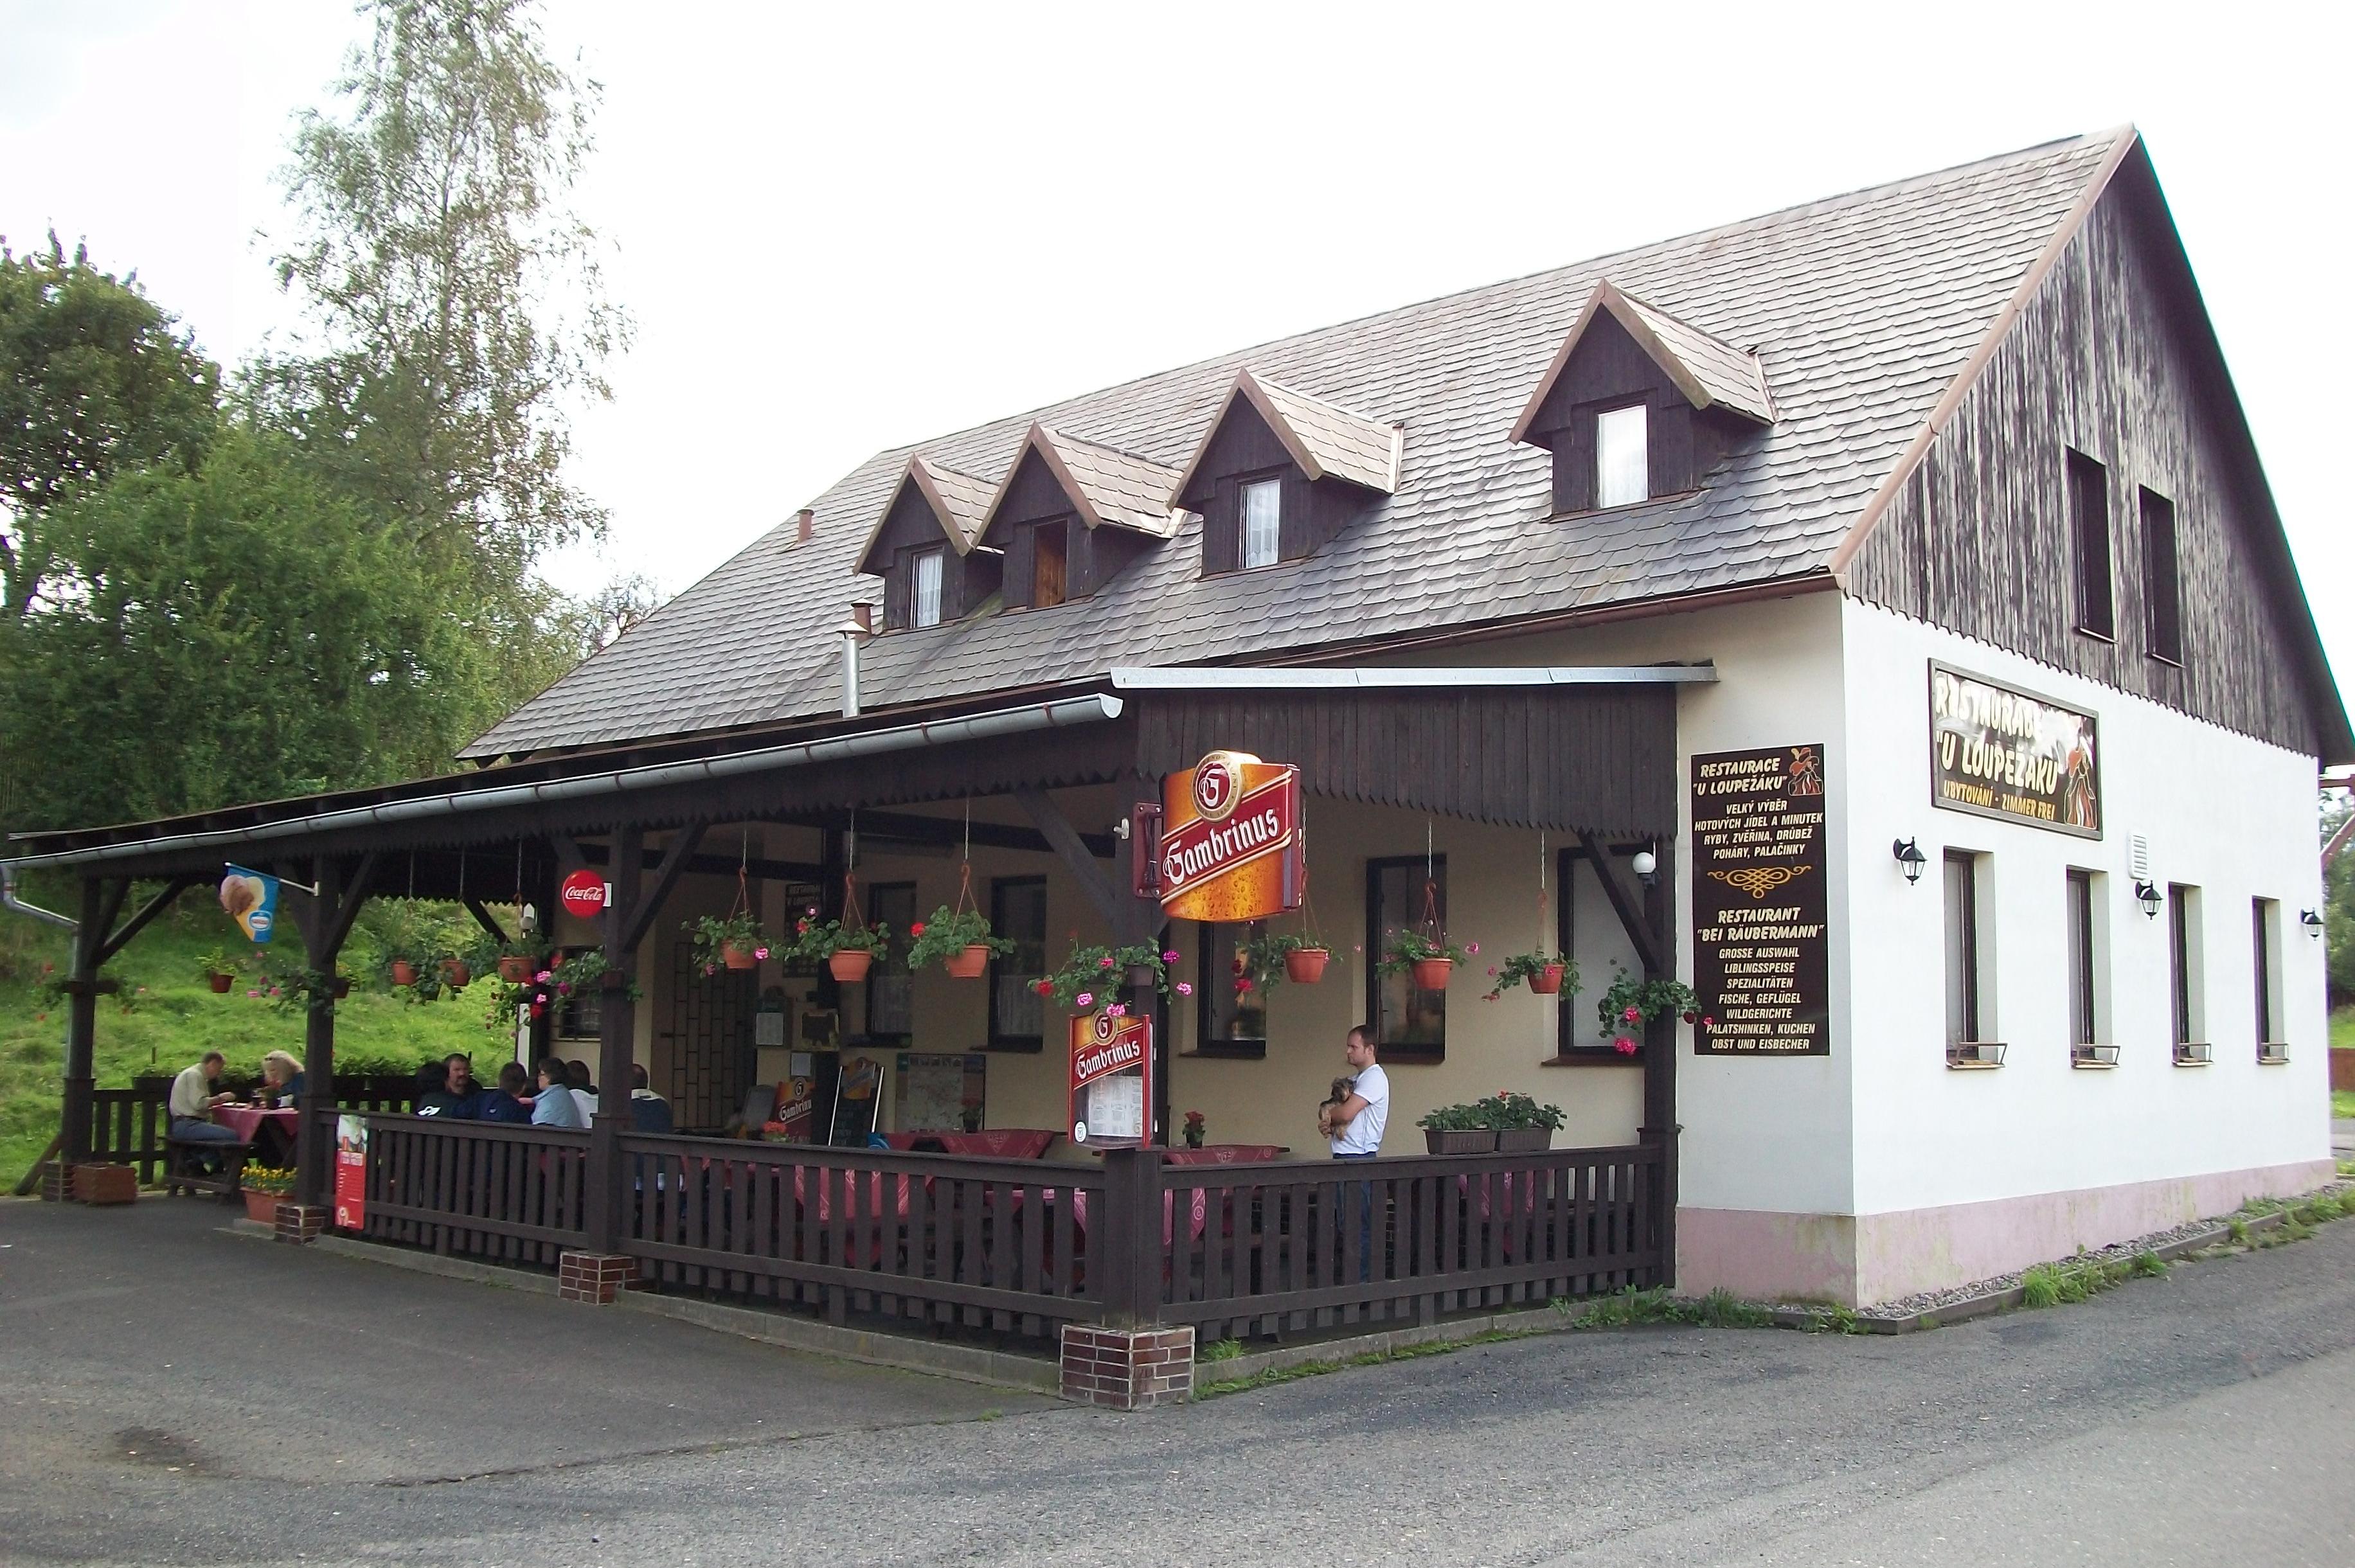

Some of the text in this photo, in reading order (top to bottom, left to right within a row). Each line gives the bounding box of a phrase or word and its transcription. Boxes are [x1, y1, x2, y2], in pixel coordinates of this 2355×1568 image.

[1701, 758, 1780, 778] RESTAURACE
[1693, 774, 1787, 796] "U LOUPEŽÁKU"
[1726, 799, 1787, 815] VELKÝ VÝBĚR
[1944, 780, 1993, 807] UBYTOVÁNÍ
[2001, 794, 2036, 817] ZIMMER
[2037, 801, 2055, 821] FREI
[1695, 813, 1823, 831] HOTOVÝCH JÍDEL A MINUTEK
[1704, 826, 1813, 845] RYBY, ZVĚŘINA, DRŮBEŽ
[1163, 808, 1279, 885] Gambrinus
[1713, 842, 1805, 860] POHÁRY, PALAČINKY
[1718, 907, 1800, 924] RESTAURANT
[1697, 924, 1824, 941] "BEI RÄUBERMANN"
[1719, 947, 1800, 959] GROSSE AUSWAHL
[1724, 962, 1795, 974] LIBLINGSSPEISE
[1726, 976, 1793, 989] SPEZIALITÄTEN
[1719, 991, 1802, 1006] FISCHE, GEFLÜGEL
[1726, 1008, 1793, 1019] WILDGERICHTE
[1706, 1023, 1815, 1035] PALATSHINKEN, KUCHEN
[1712, 1038, 1810, 1049] OBST UND EISBECHER
[1076, 1040, 1140, 1080] Gambrinus
[779, 1099, 812, 1121] Gambrinu
